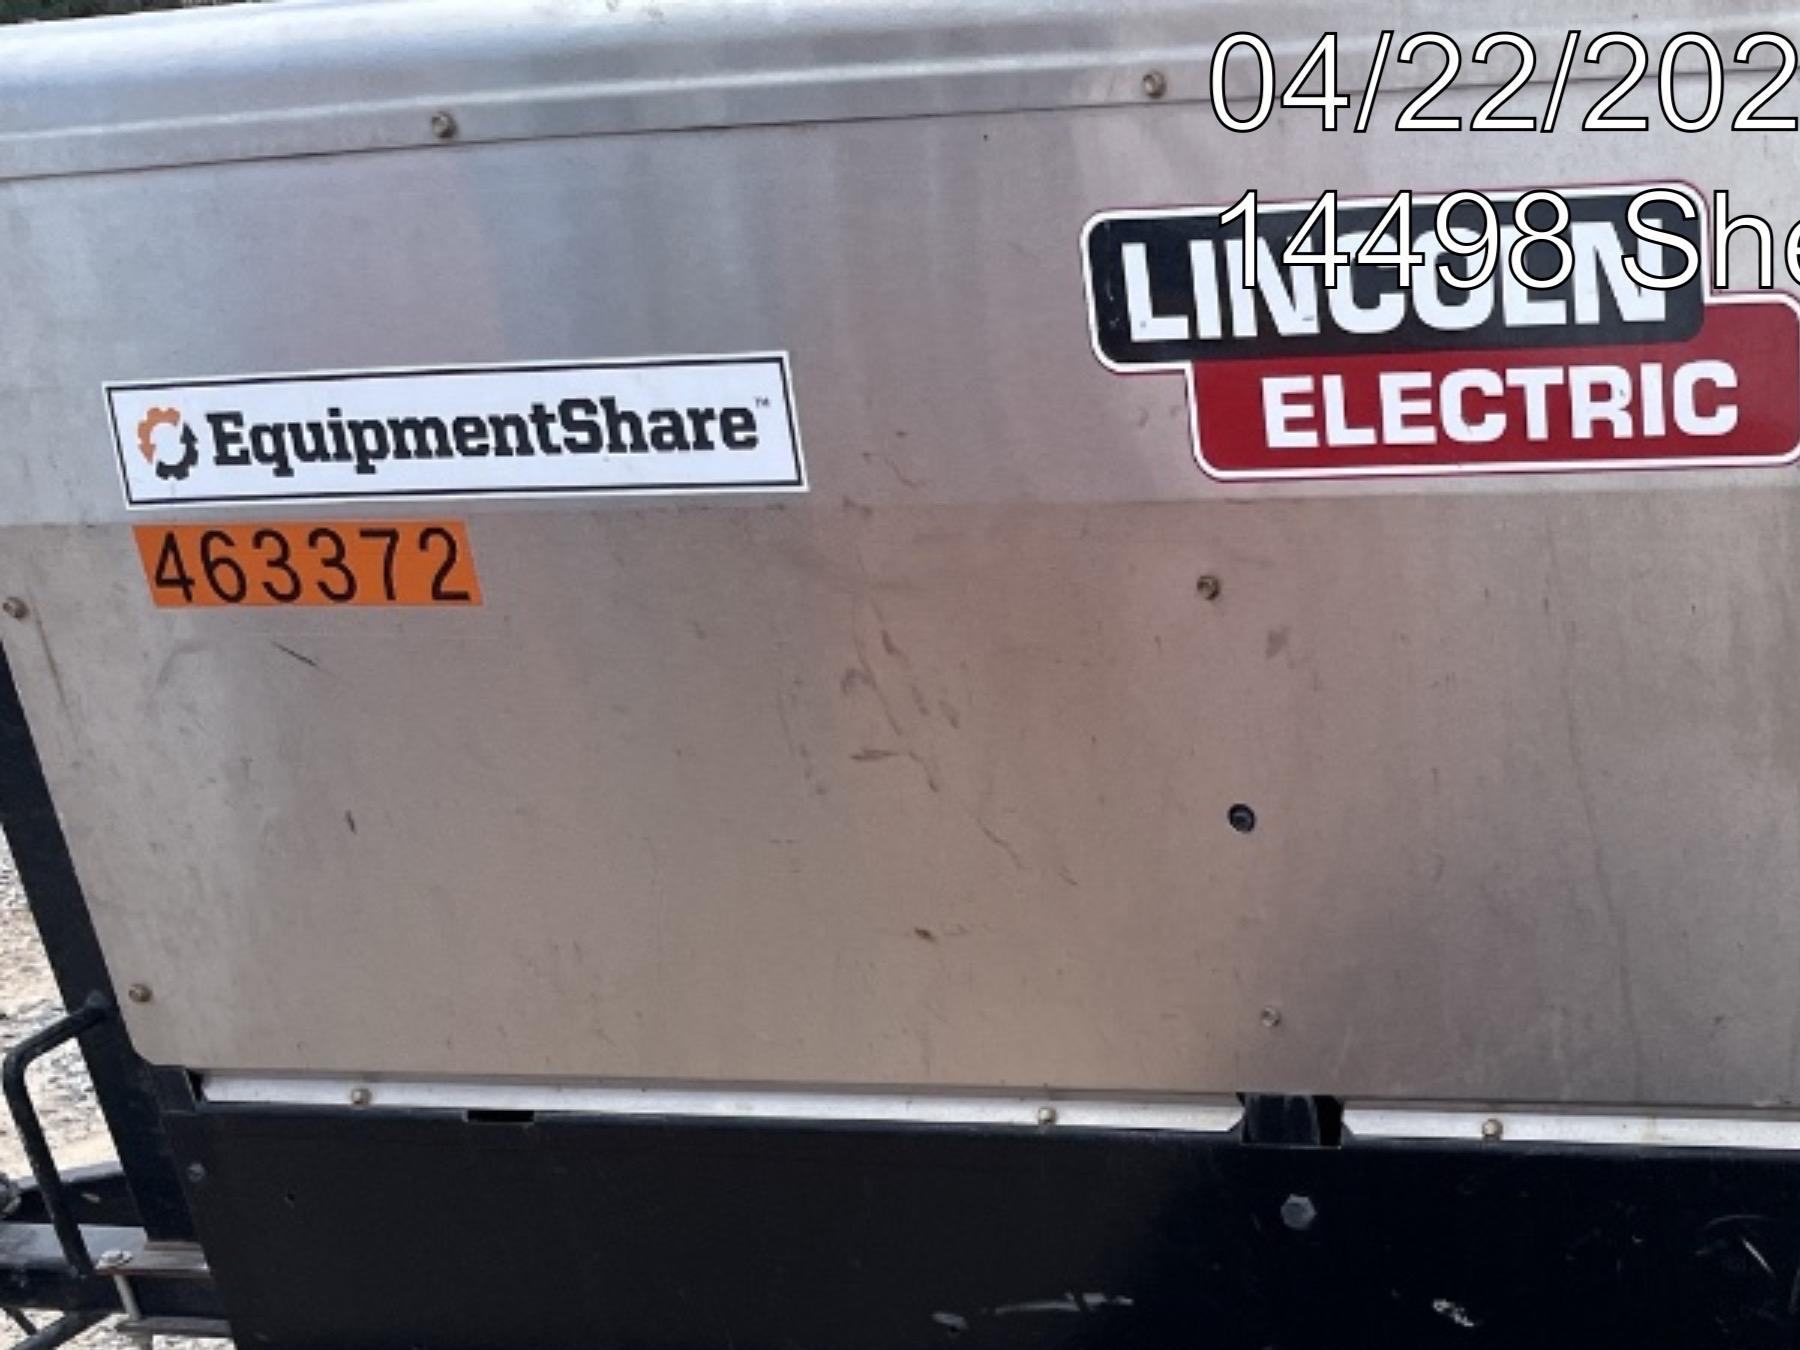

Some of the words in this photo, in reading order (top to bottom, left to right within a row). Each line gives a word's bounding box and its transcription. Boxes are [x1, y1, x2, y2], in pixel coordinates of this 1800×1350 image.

[206, 396, 760, 478] EquipmentShare
[1261, 359, 1738, 449] ELECTRIC
[154, 527, 471, 603] 463372
